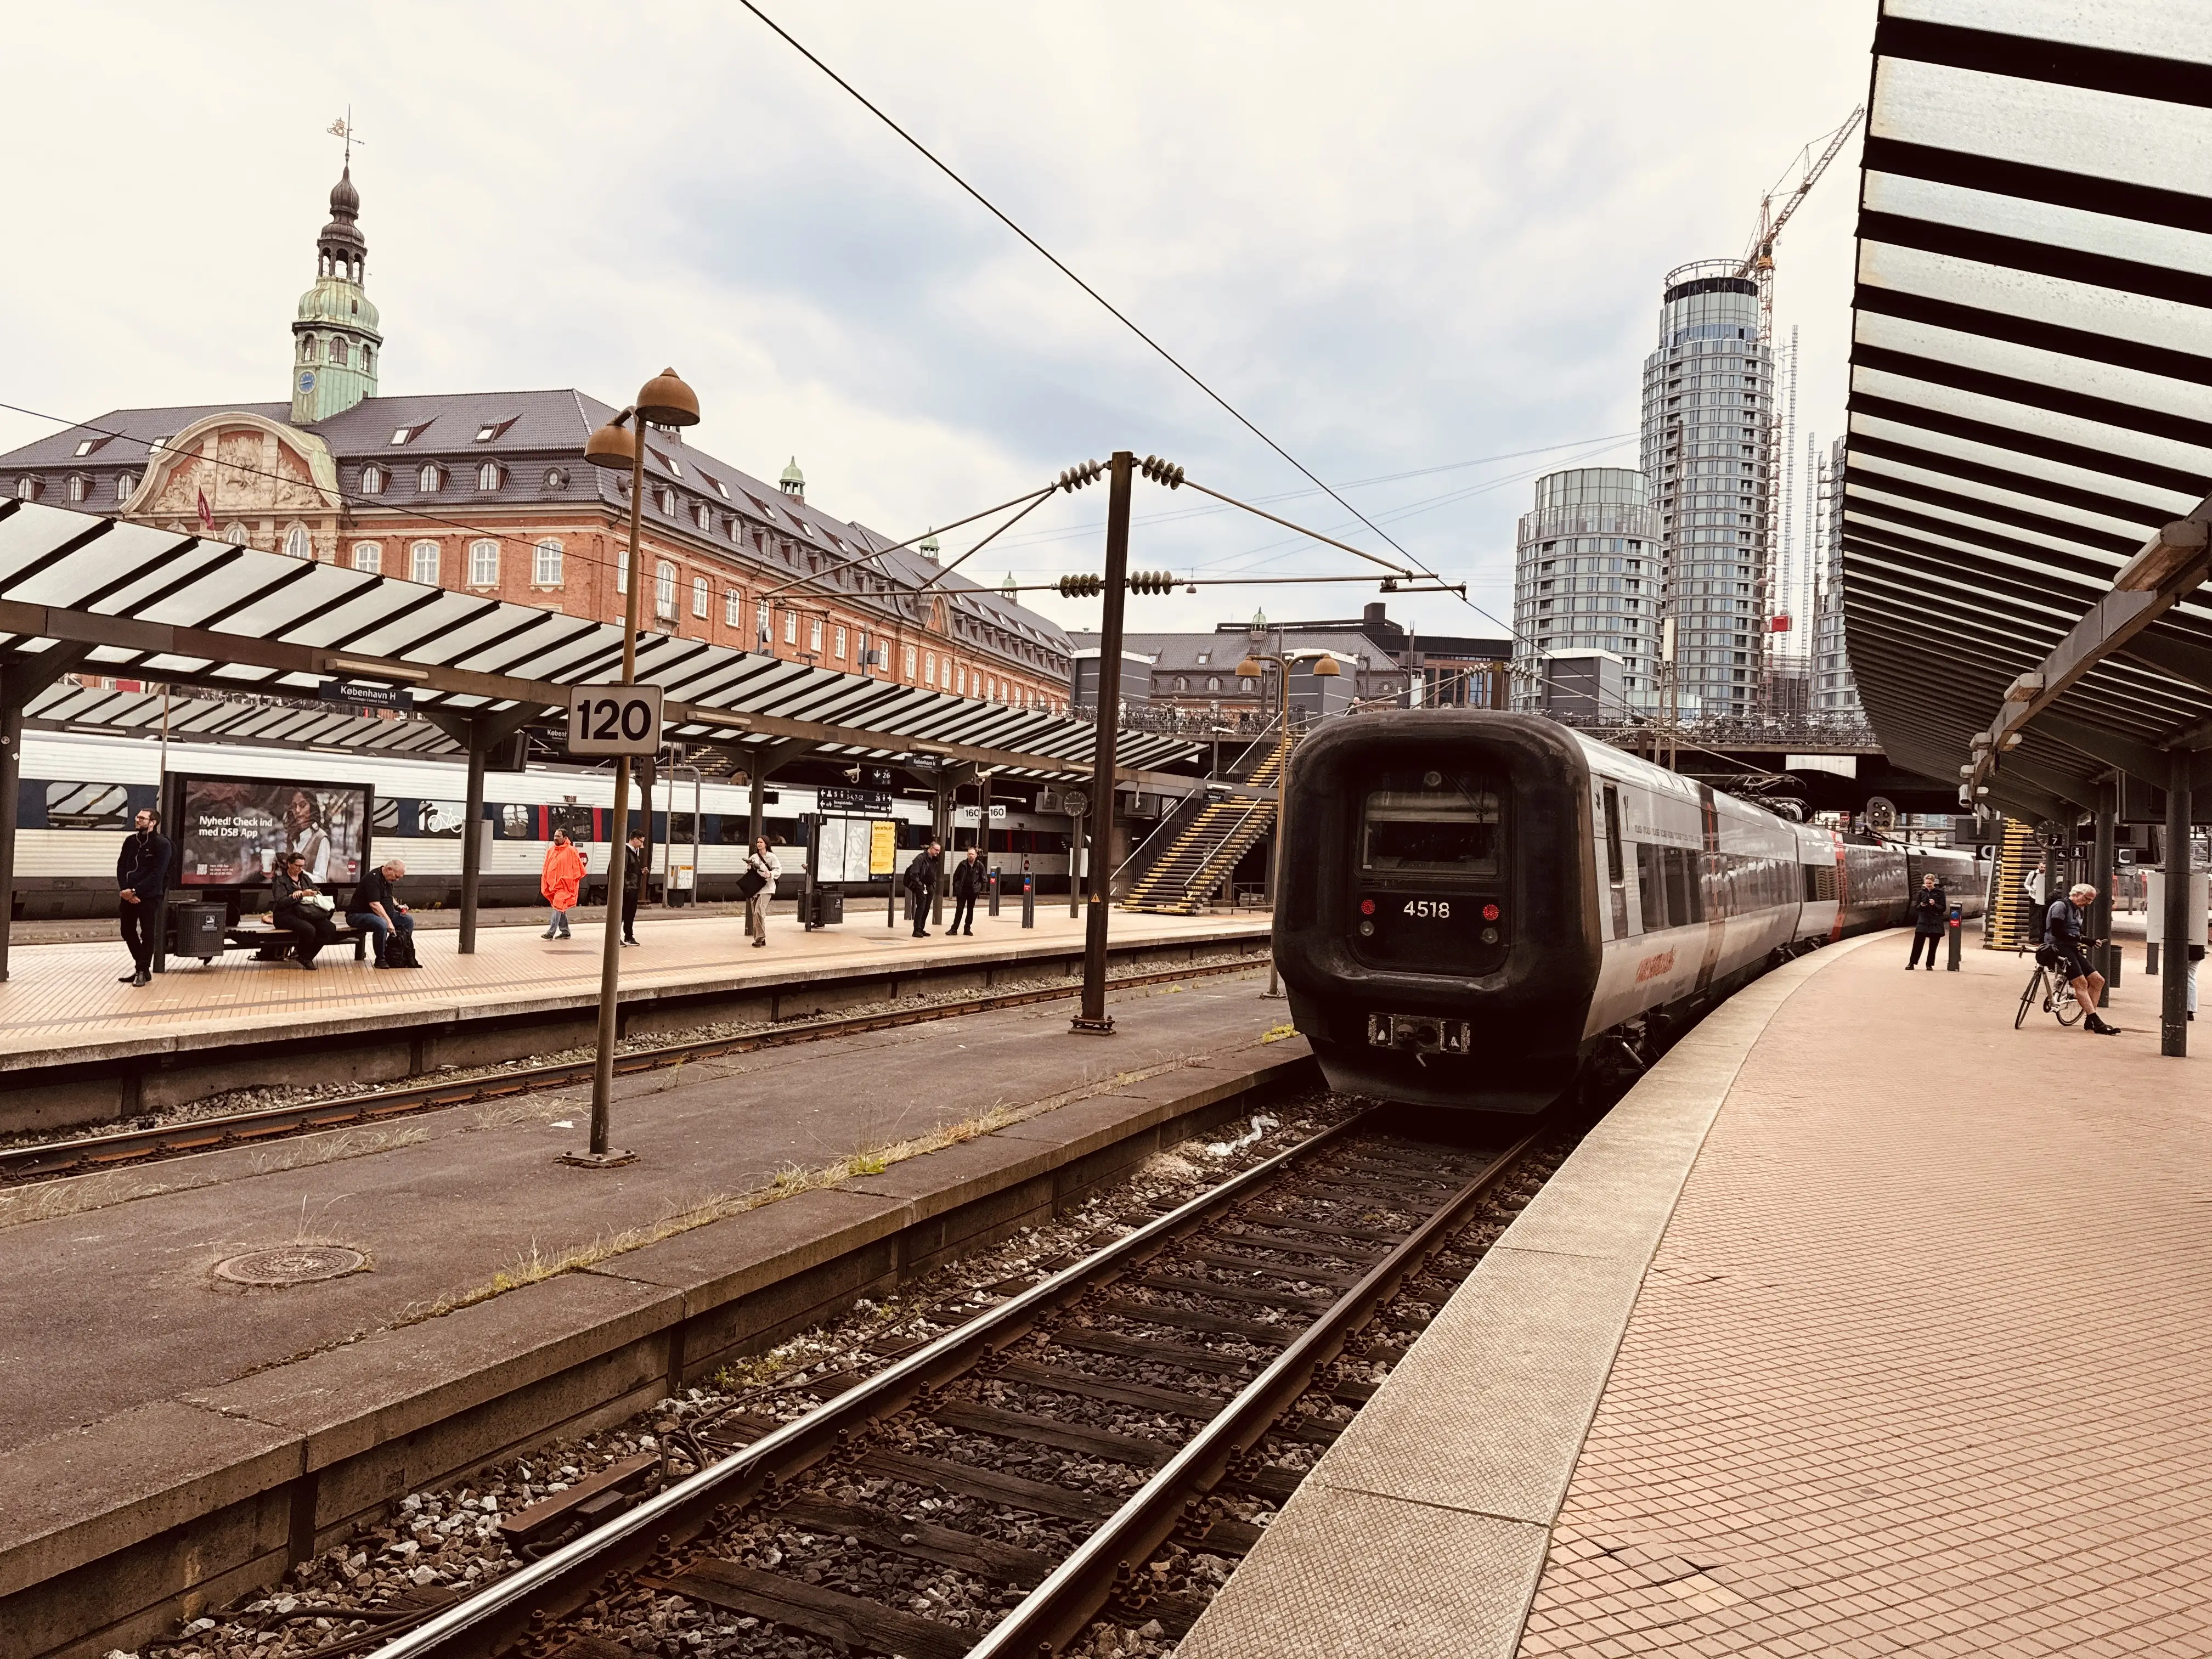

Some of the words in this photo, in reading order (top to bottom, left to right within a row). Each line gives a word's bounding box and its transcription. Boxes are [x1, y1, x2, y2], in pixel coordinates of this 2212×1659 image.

[341, 685, 387, 699] København
[390, 691, 396, 701] H
[577, 699, 651, 741] 120
[990, 808, 1004, 816] 160
[199, 815, 231, 827] Nyhed!
[233, 817, 258, 826] Check
[260, 817, 273, 827] ind
[199, 827, 218, 837] med
[221, 827, 239, 837] DSB
[240, 828, 258, 839] App
[2118, 849, 2131, 864] C
[1403, 900, 1450, 918] 4518
